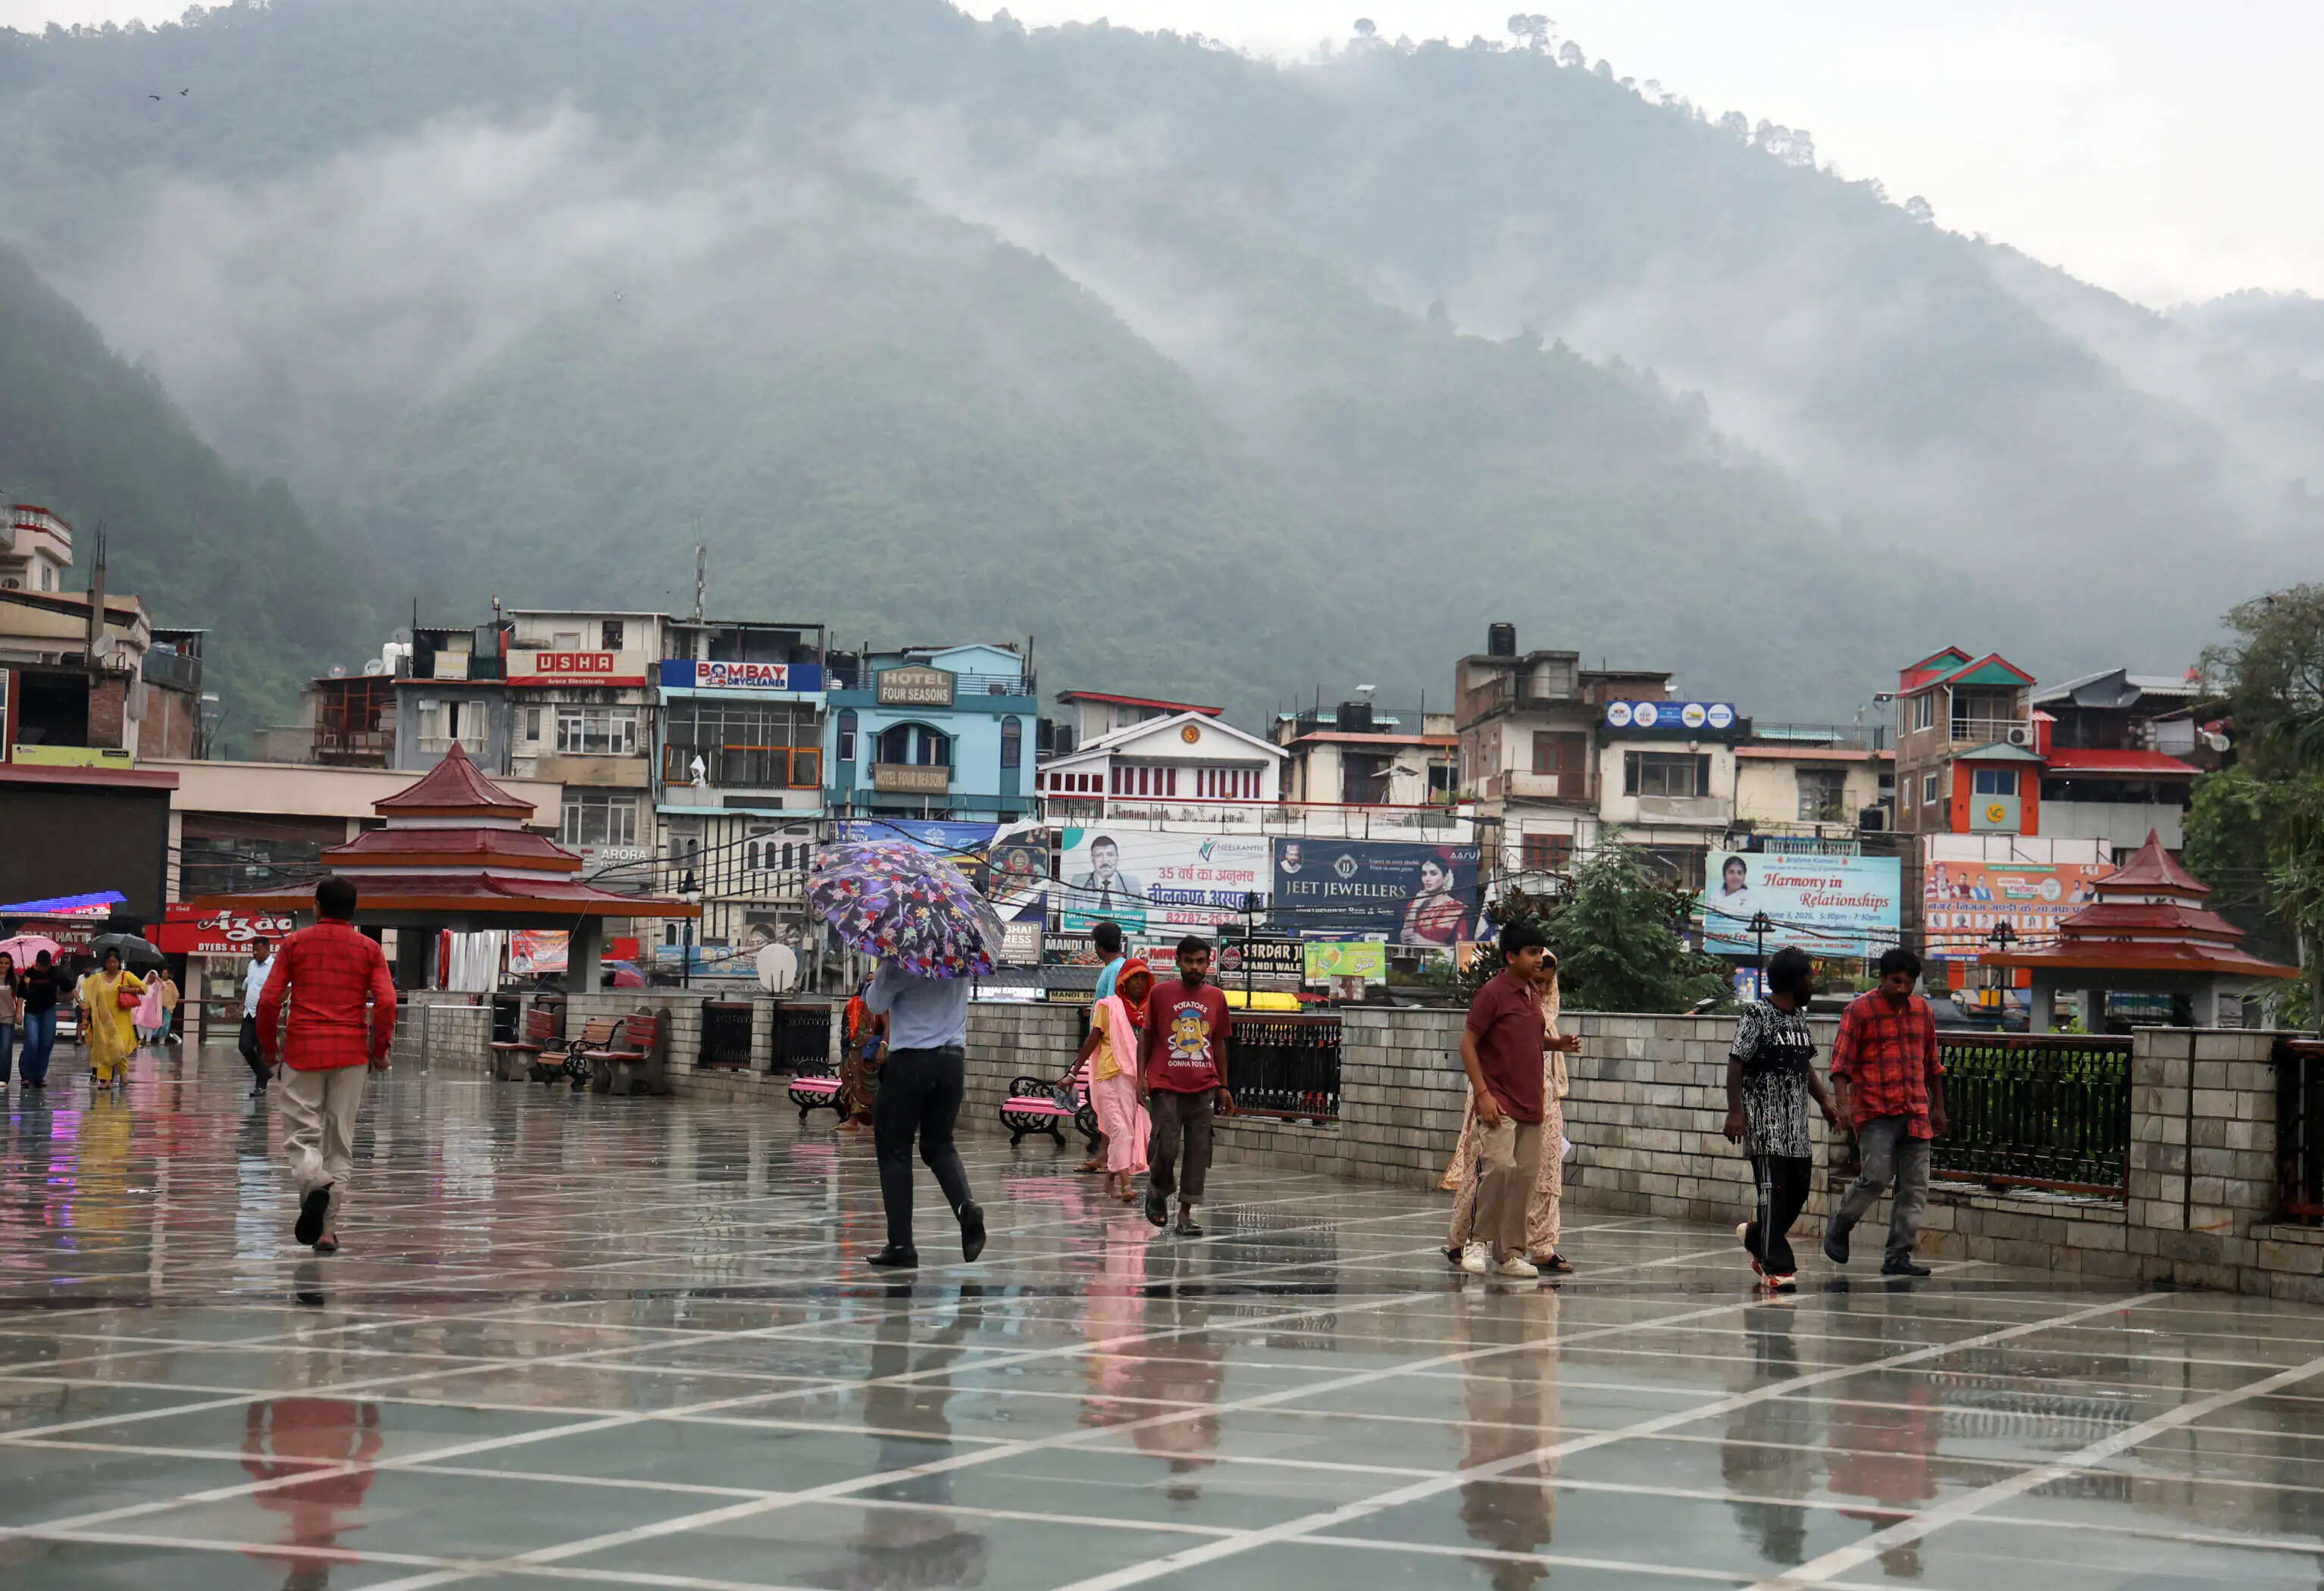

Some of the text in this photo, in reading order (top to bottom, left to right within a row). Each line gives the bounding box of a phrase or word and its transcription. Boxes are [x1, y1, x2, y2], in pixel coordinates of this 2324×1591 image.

[540, 655, 610, 670] USHA
[696, 663, 786, 680] BOMBAY
[883, 672, 948, 685] HOTEL
[727, 677, 786, 687] DRYCLEANER
[882, 686, 949, 702] FOUR SEASONS
[898, 770, 916, 786] FOUR
[600, 849, 647, 861] ARORA
[1159, 864, 1255, 886] 35 वर्ष का अनुभव
[1763, 873, 1843, 892] Harmony in
[1286, 880, 1407, 898] JEET JEWELLERS
[1800, 891, 1890, 912] Relationships
[1004, 934, 1031, 944] RESS
[1044, 938, 1082, 951] MANDI
[198, 942, 227, 952] DYERS
[1243, 943, 1290, 959] SARDAR
[1242, 961, 1301, 971] MANDI WALE
[1173, 1001, 1209, 1013] POTATOES
